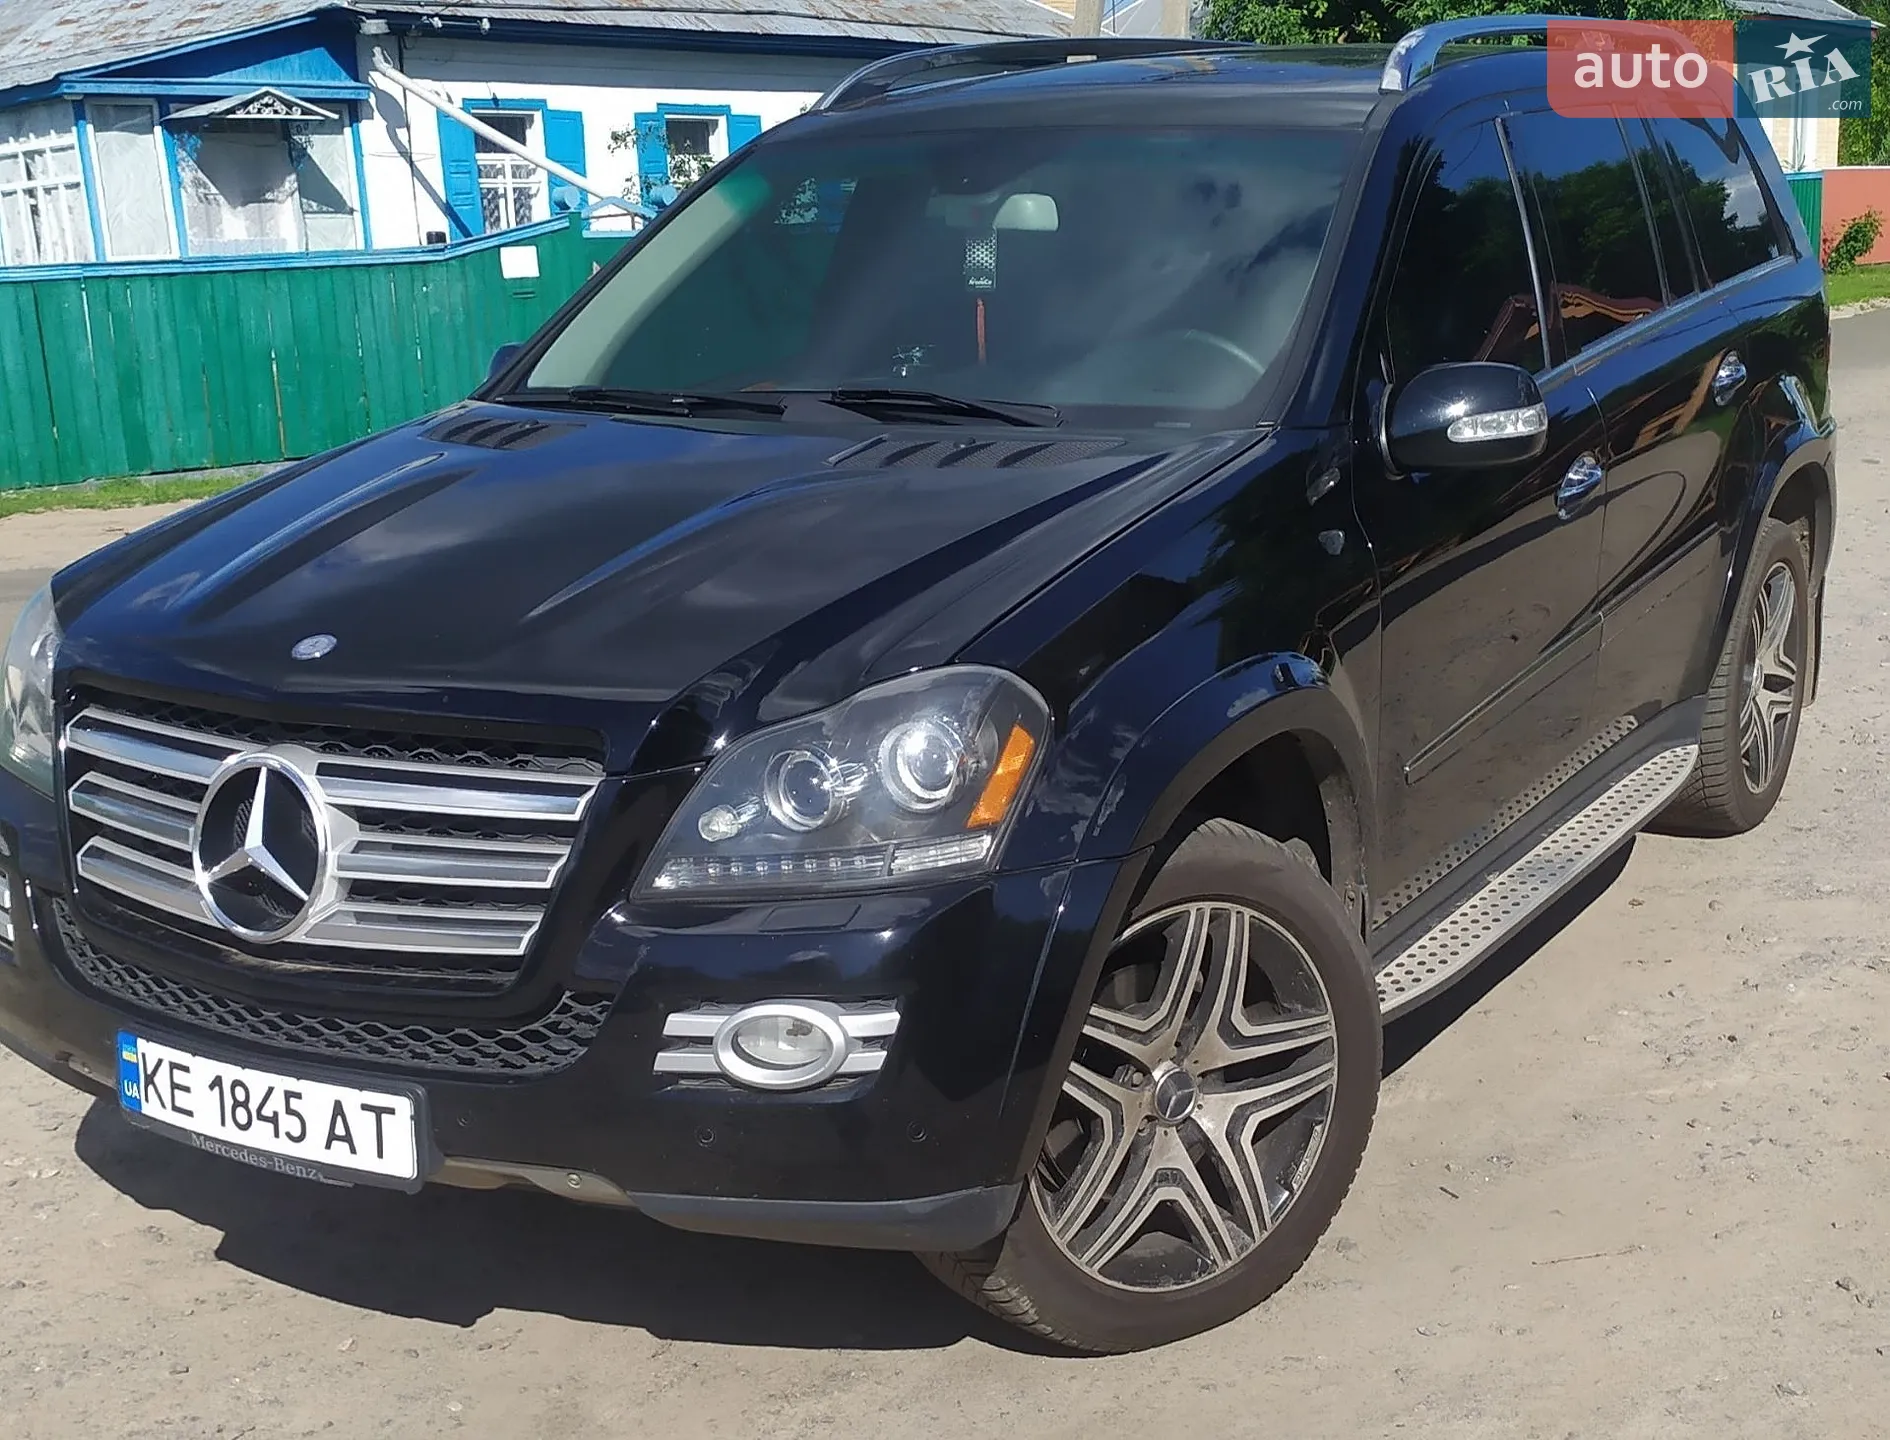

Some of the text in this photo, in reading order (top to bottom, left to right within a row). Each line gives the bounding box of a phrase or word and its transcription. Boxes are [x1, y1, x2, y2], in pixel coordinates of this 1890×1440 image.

[124, 1079, 140, 1100] UA
[141, 1052, 397, 1159] KE 1845 AT
[188, 1131, 319, 1180] Mercedes-Benz
